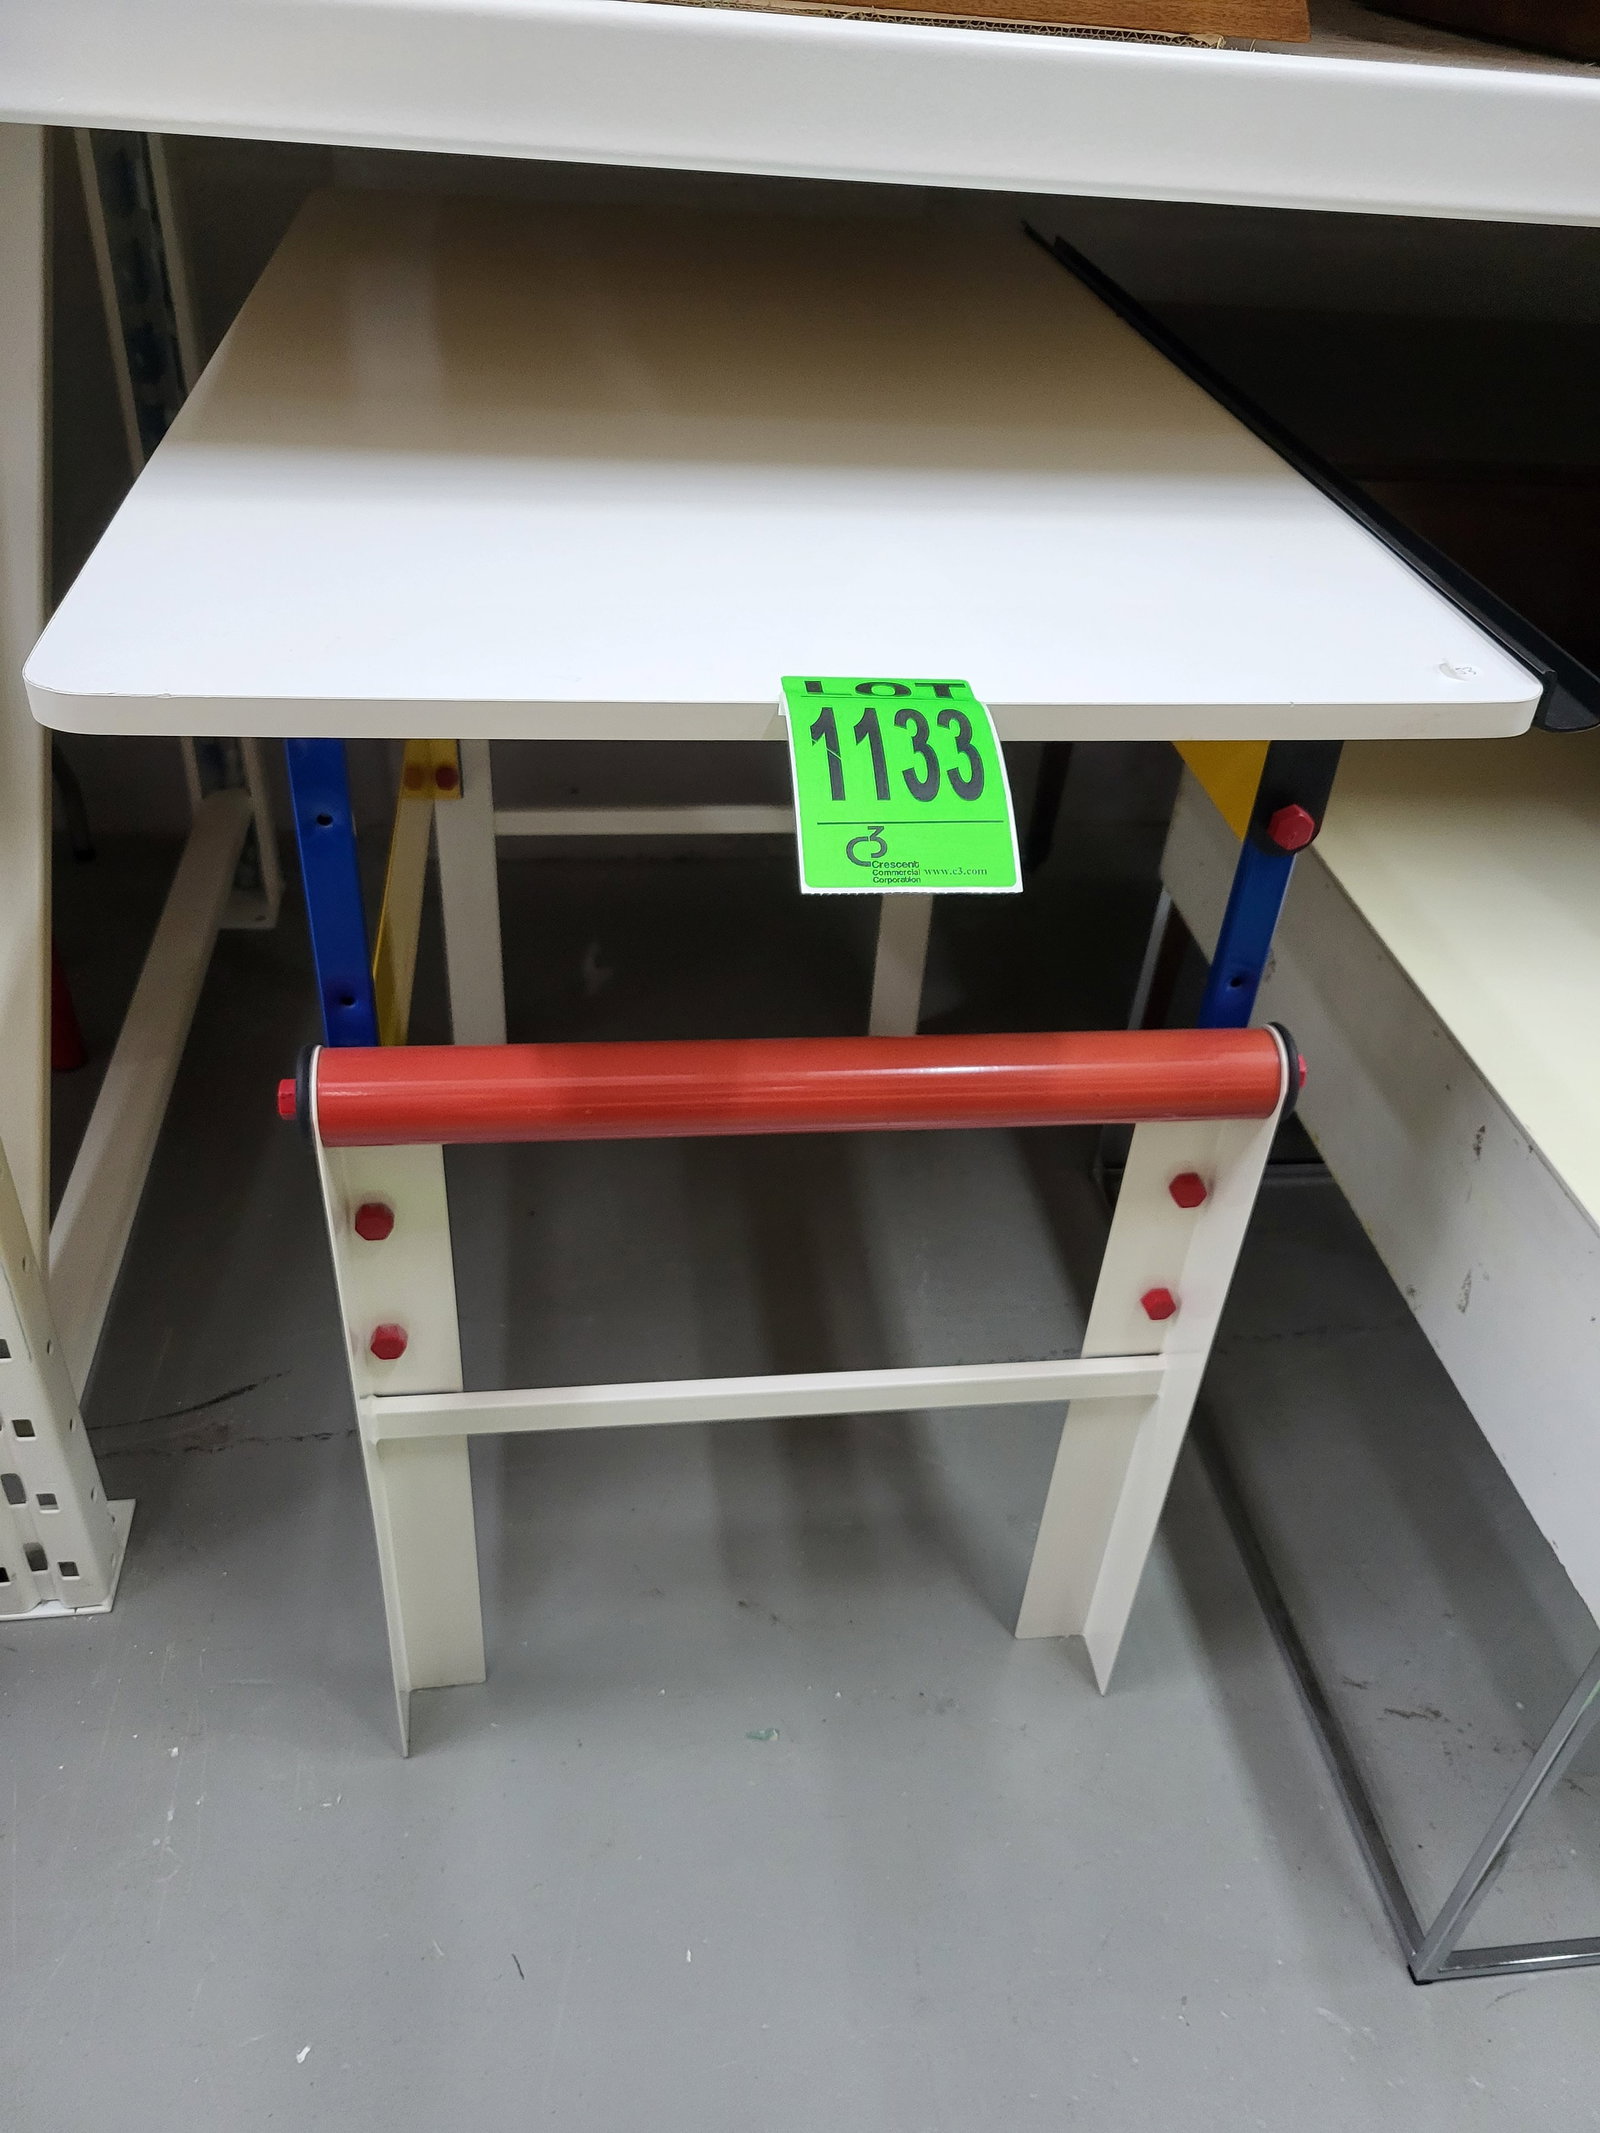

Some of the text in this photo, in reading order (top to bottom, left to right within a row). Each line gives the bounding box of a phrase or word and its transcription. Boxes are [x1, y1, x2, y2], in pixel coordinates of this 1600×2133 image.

[804, 680, 966, 699] LOT
[809, 706, 985, 802] 1133
[871, 860, 920, 869] Crescent
[924, 867, 988, 876] www.c3.com
[872, 876, 922, 884] Corporation
